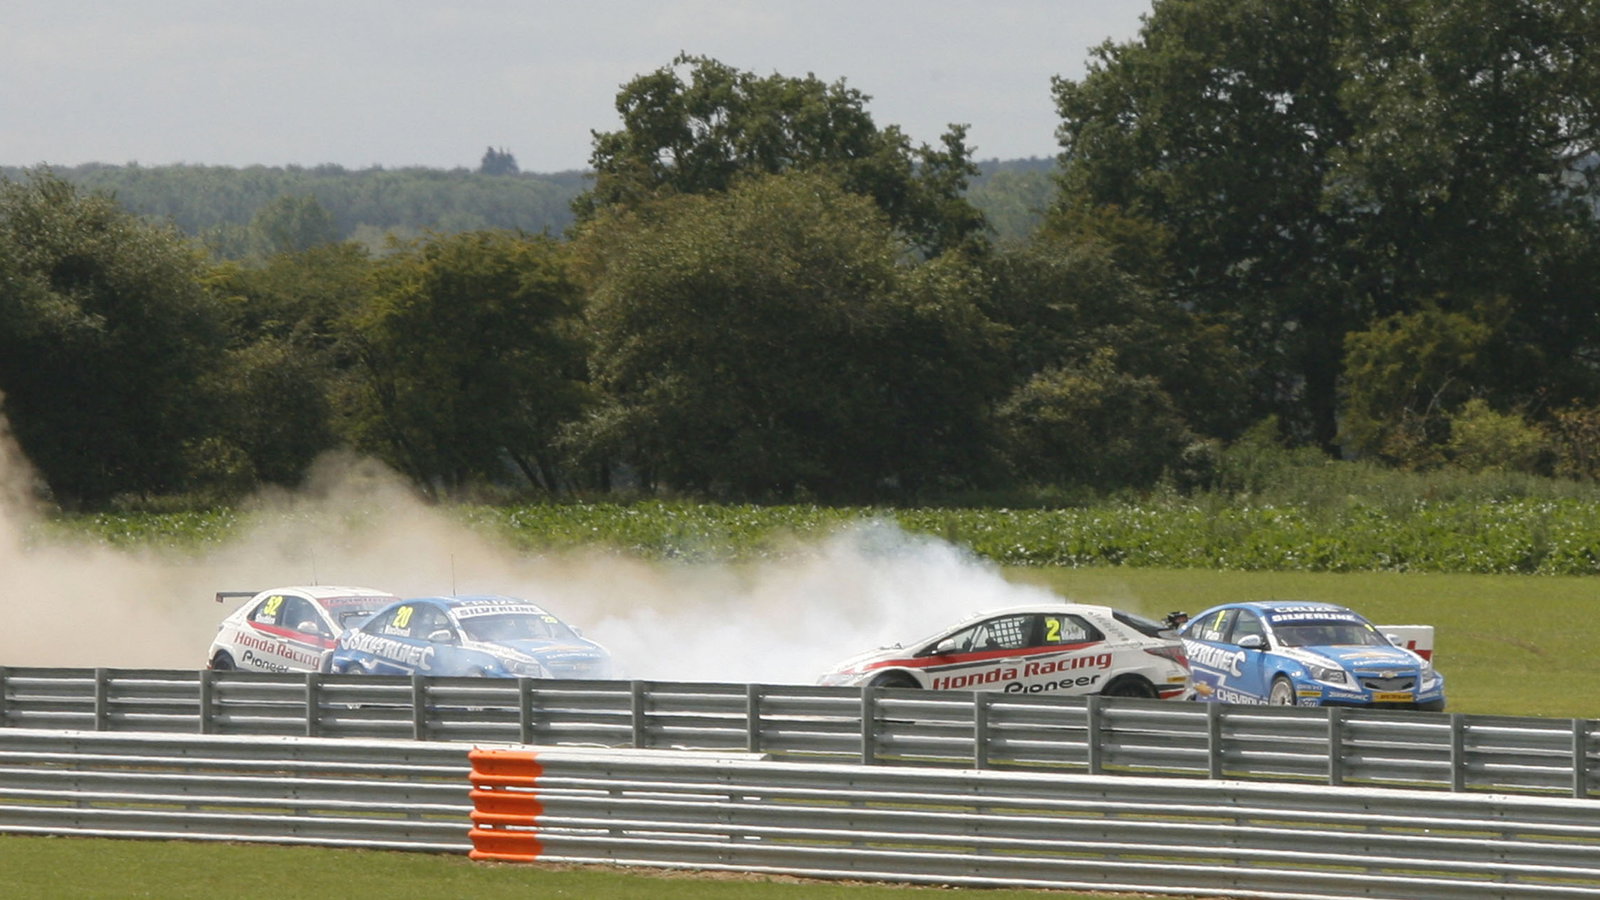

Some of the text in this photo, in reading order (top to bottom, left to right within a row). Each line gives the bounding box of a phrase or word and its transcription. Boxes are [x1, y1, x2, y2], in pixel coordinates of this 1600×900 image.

[263, 596, 283, 616] 52
[459, 606, 538, 616] SILVERLINE
[392, 606, 414, 628] 20
[1213, 610, 1226, 631] 1
[1272, 613, 1356, 622] SILVERLINE
[1046, 620, 1061, 641] 2
[234, 631, 321, 671] Honda Racing
[242, 650, 289, 673] Pioneer
[932, 652, 1113, 690] Honda Racing
[1004, 674, 1101, 694] Pioneer
[1216, 688, 1269, 705] CHEVRO
